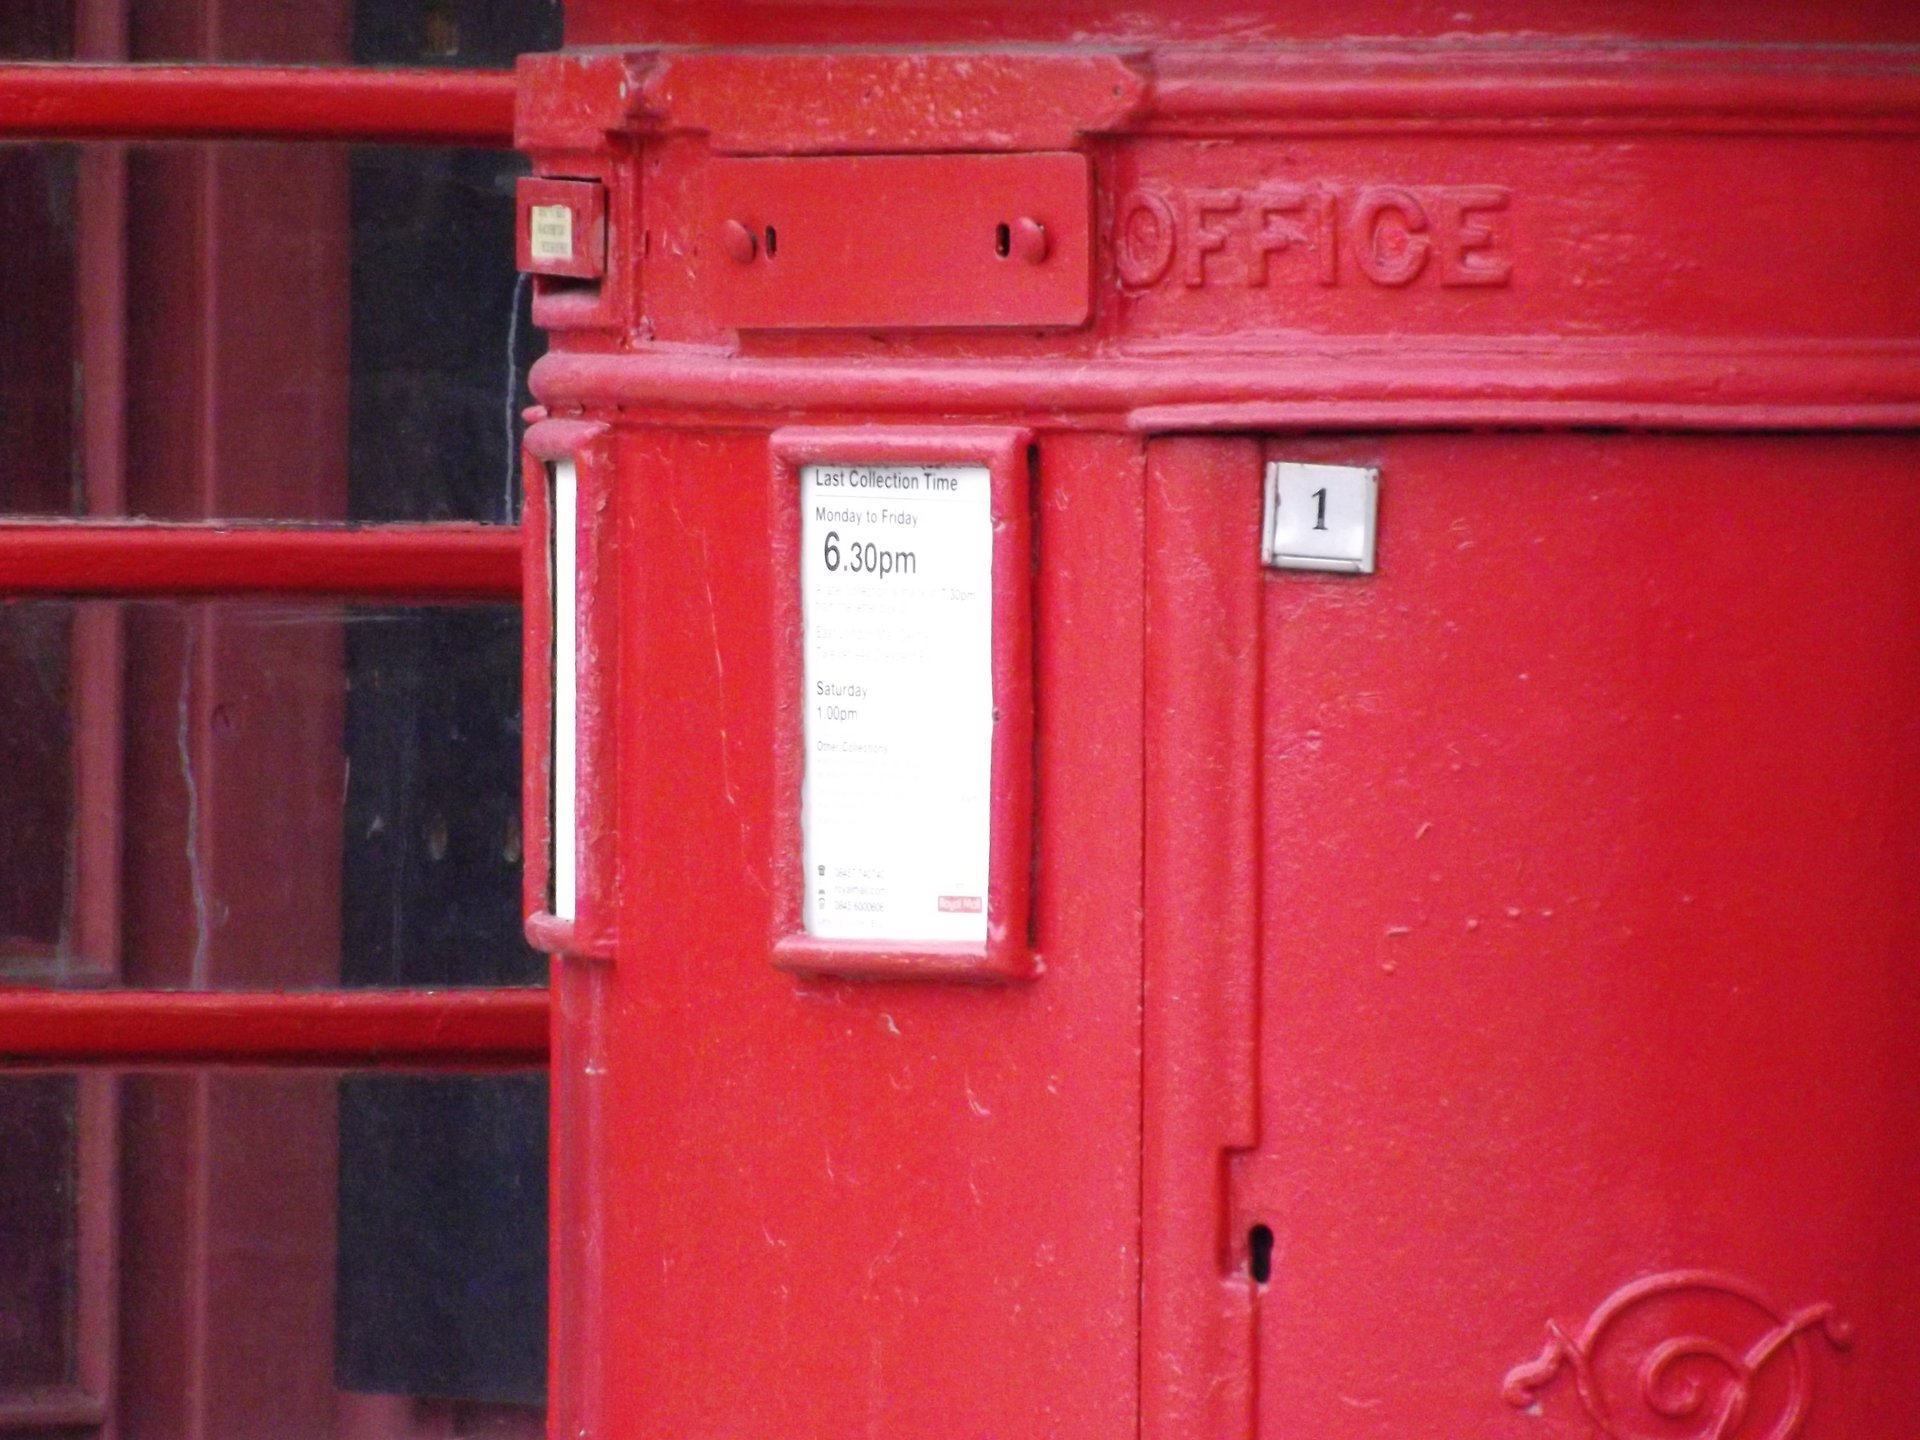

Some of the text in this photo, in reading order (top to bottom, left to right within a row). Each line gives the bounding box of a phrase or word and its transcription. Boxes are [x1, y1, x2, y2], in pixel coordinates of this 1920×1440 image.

[1115, 182, 1513, 289] OFFICE
[816, 469, 958, 491] Last Collection Time
[816, 506, 918, 527] Monday to Friday
[1311, 487, 1328, 530] 1
[824, 530, 917, 579] 6.30pm
[816, 680, 868, 700] Saturday
[817, 705, 858, 724] 1.00pm
